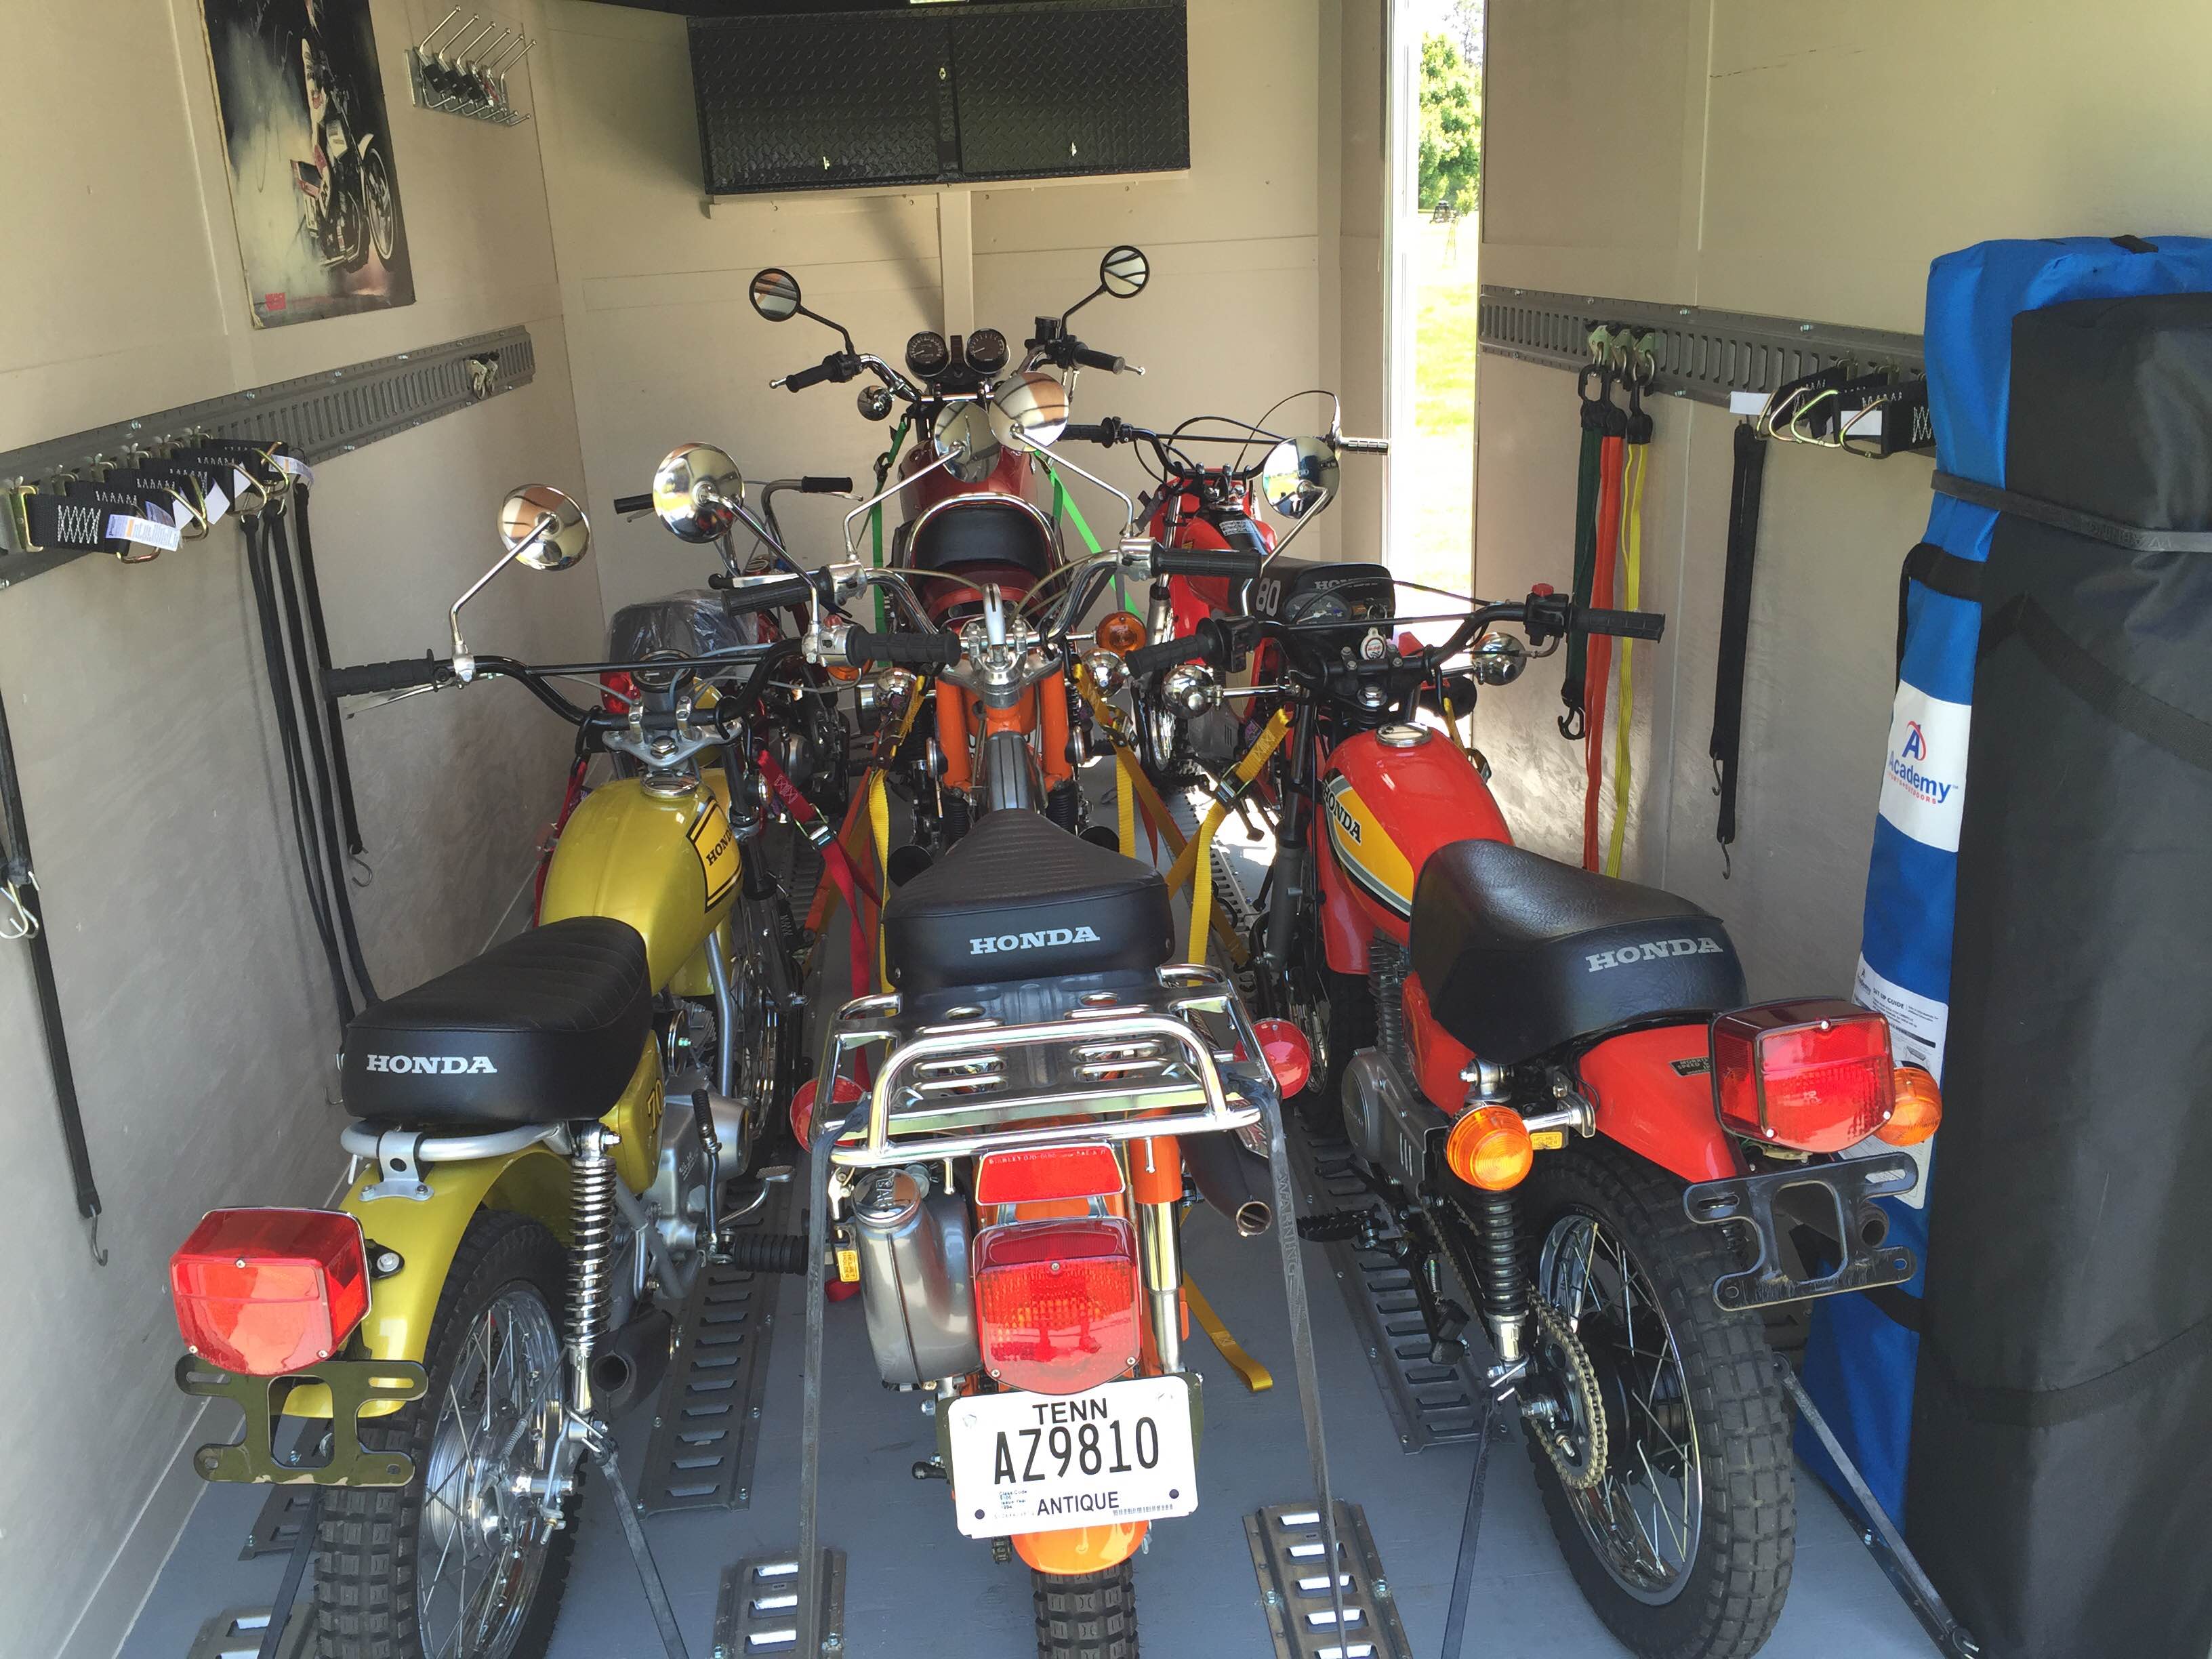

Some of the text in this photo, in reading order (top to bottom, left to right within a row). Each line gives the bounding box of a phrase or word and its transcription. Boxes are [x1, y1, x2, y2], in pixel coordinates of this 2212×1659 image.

[1256, 577, 1281, 617] 80
[1889, 750, 1951, 804] Academy
[706, 824, 732, 866] HOND
[969, 926, 1101, 955] HONDA
[1586, 937, 1723, 972] HONDA
[1880, 993, 1887, 1001] UP
[1887, 998, 1904, 1009] GUIDE
[366, 1054, 497, 1075] HONDA
[647, 1078, 663, 1134] 70
[1277, 1172, 1297, 1276] WARNING
[1032, 1397, 1107, 1425] TENN
[994, 1416, 1158, 1485] AZ9810
[1037, 1491, 1120, 1516] ANTIQUE
